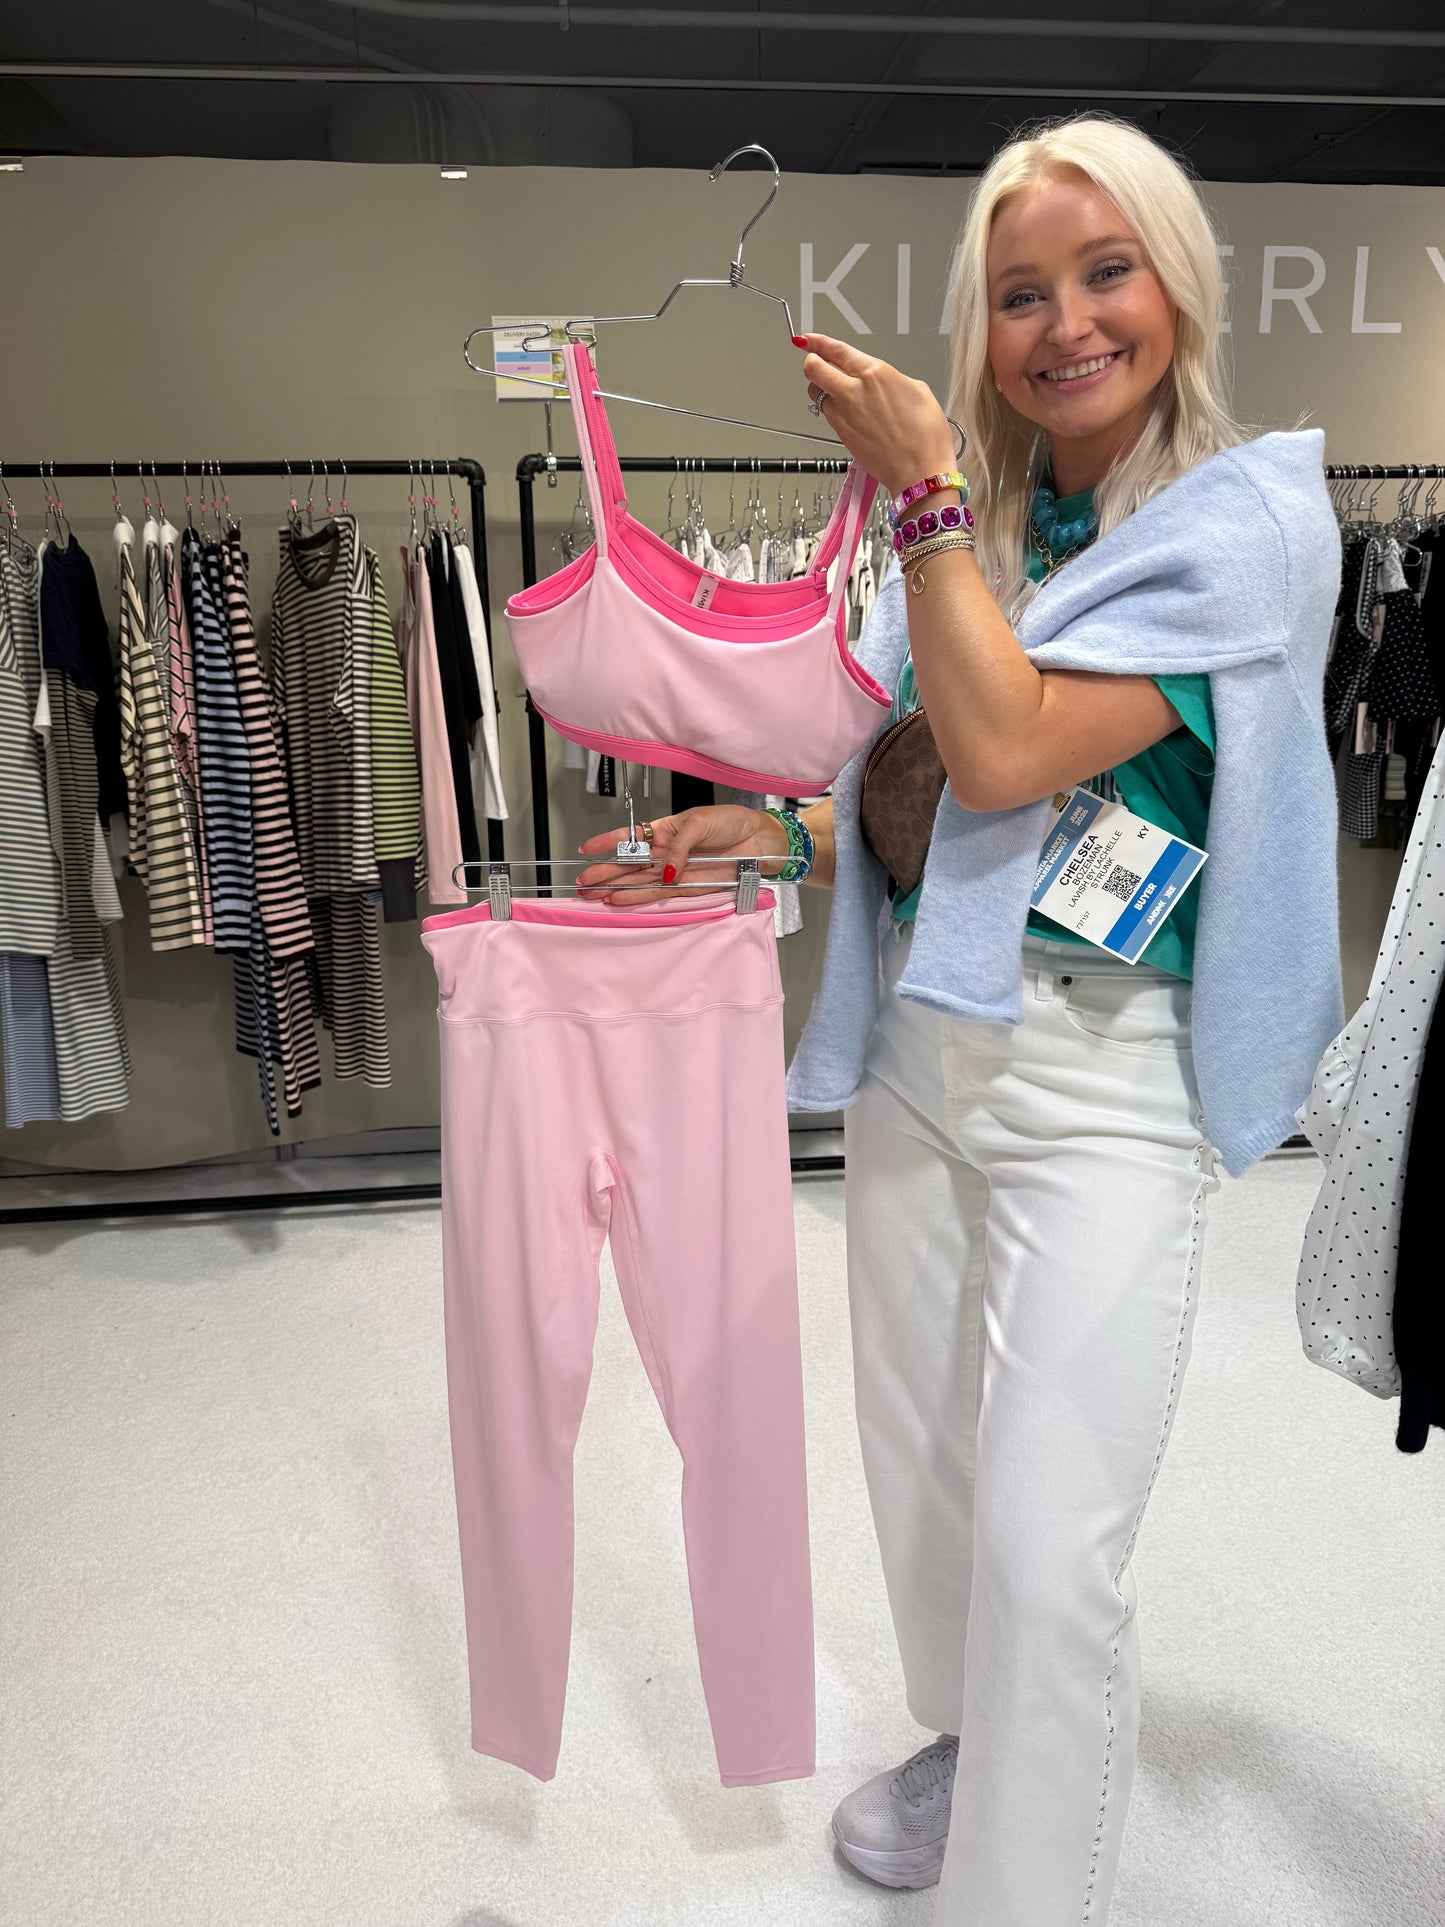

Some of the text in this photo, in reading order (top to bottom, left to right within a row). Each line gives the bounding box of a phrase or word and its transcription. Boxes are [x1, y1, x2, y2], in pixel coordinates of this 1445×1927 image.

[1069, 805, 1083, 824] JUNE
[1074, 809, 1089, 827] 2026
[1045, 832, 1065, 860] MARKET
[1136, 825, 1150, 839] KY
[1033, 836, 1070, 892] APPAREL MARKET
[1059, 834, 1099, 886] CHELSEA
[1068, 829, 1123, 908] LAVISH BY LACHELLE
[1072, 843, 1103, 886] BOZEMAN
[1090, 857, 1115, 889] STRUNK
[1133, 882, 1157, 911] BUYER
[1075, 910, 1091, 930] 737157
